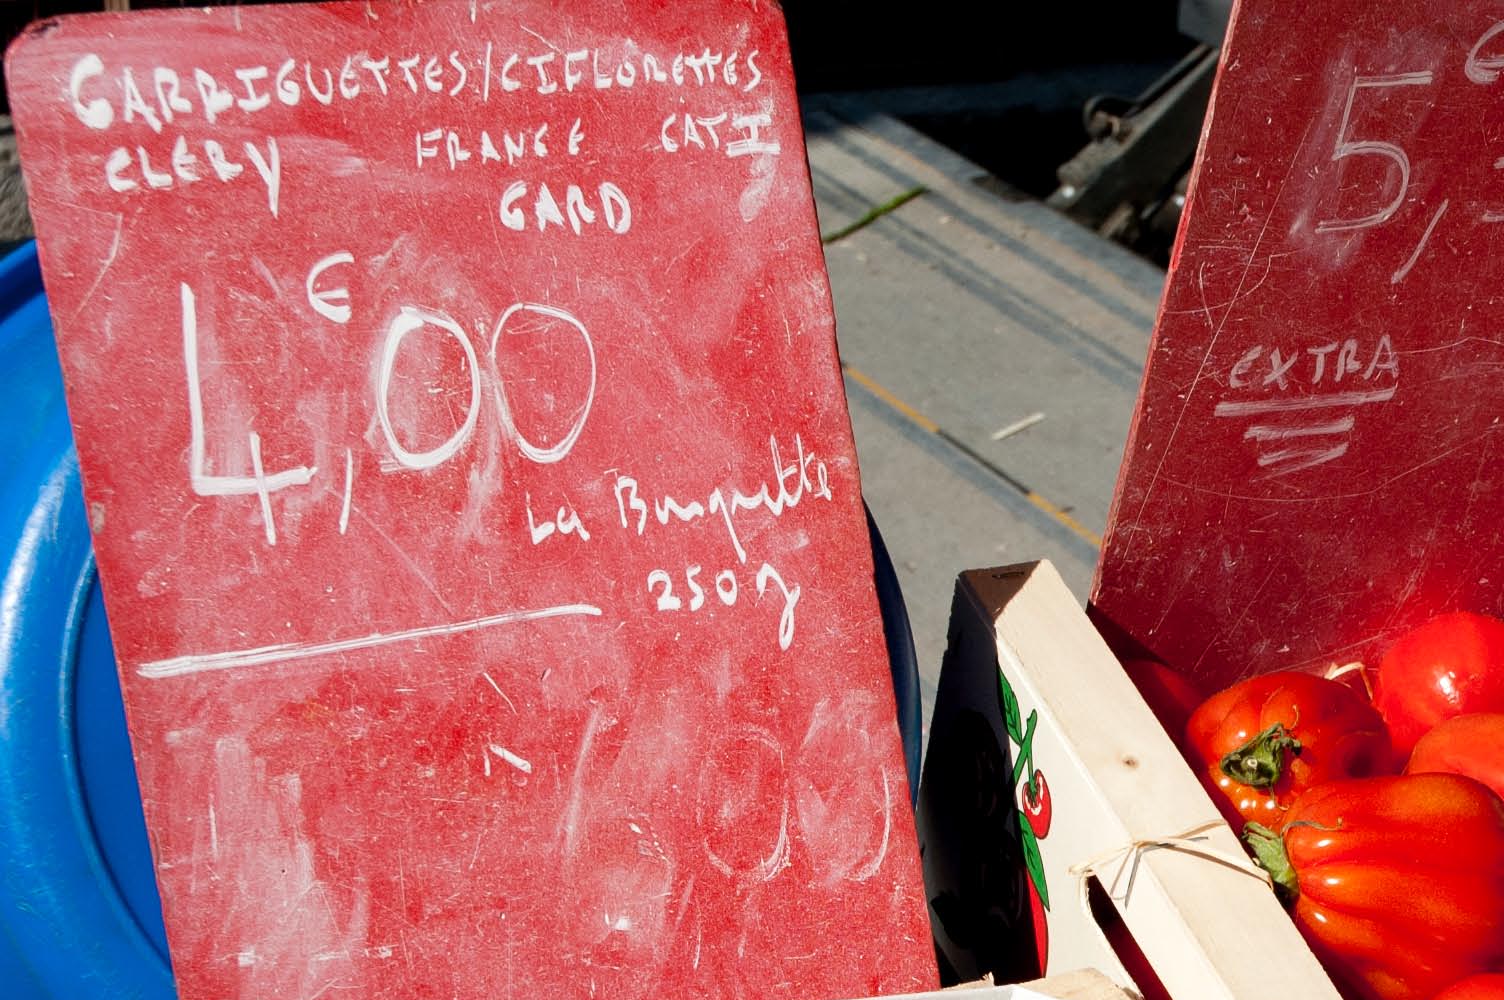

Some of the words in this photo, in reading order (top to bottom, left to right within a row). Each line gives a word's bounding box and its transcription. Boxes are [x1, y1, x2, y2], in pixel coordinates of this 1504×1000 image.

[415, 117, 586, 170] FRANCE
[660, 112, 728, 152] CAT
[500, 179, 632, 236] GARD
